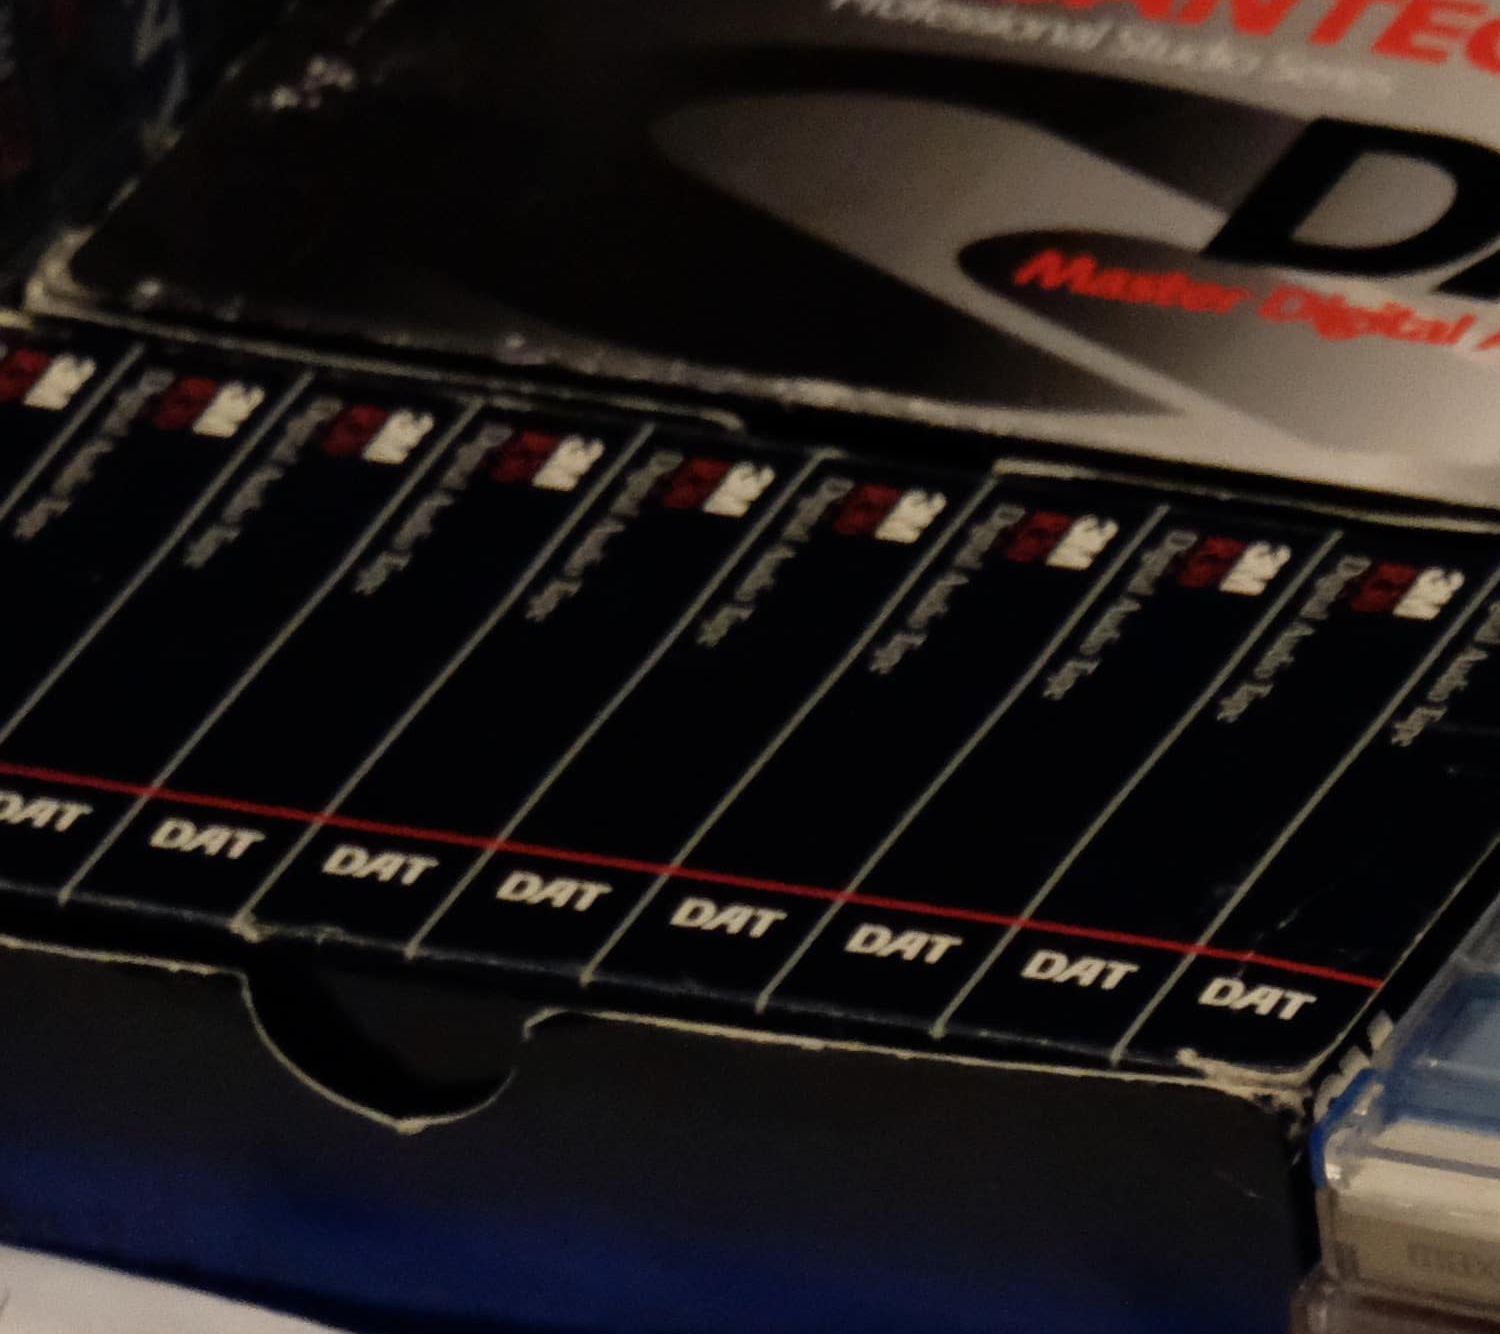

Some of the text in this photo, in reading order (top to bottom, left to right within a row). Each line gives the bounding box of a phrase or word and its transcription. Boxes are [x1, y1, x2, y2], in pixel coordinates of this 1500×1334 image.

[1111, 12, 1261, 78] Studio
[1012, 249, 1252, 317] Master
[1258, 284, 1465, 350] Digital
[0, 791, 92, 832] DAT
[151, 818, 264, 859] DAT
[323, 844, 438, 885] DAT
[496, 871, 611, 912] DAT
[671, 897, 787, 938] DAT
[846, 923, 962, 964] DAT
[1022, 949, 1138, 990] DAT
[1199, 977, 1316, 1019] DAT
